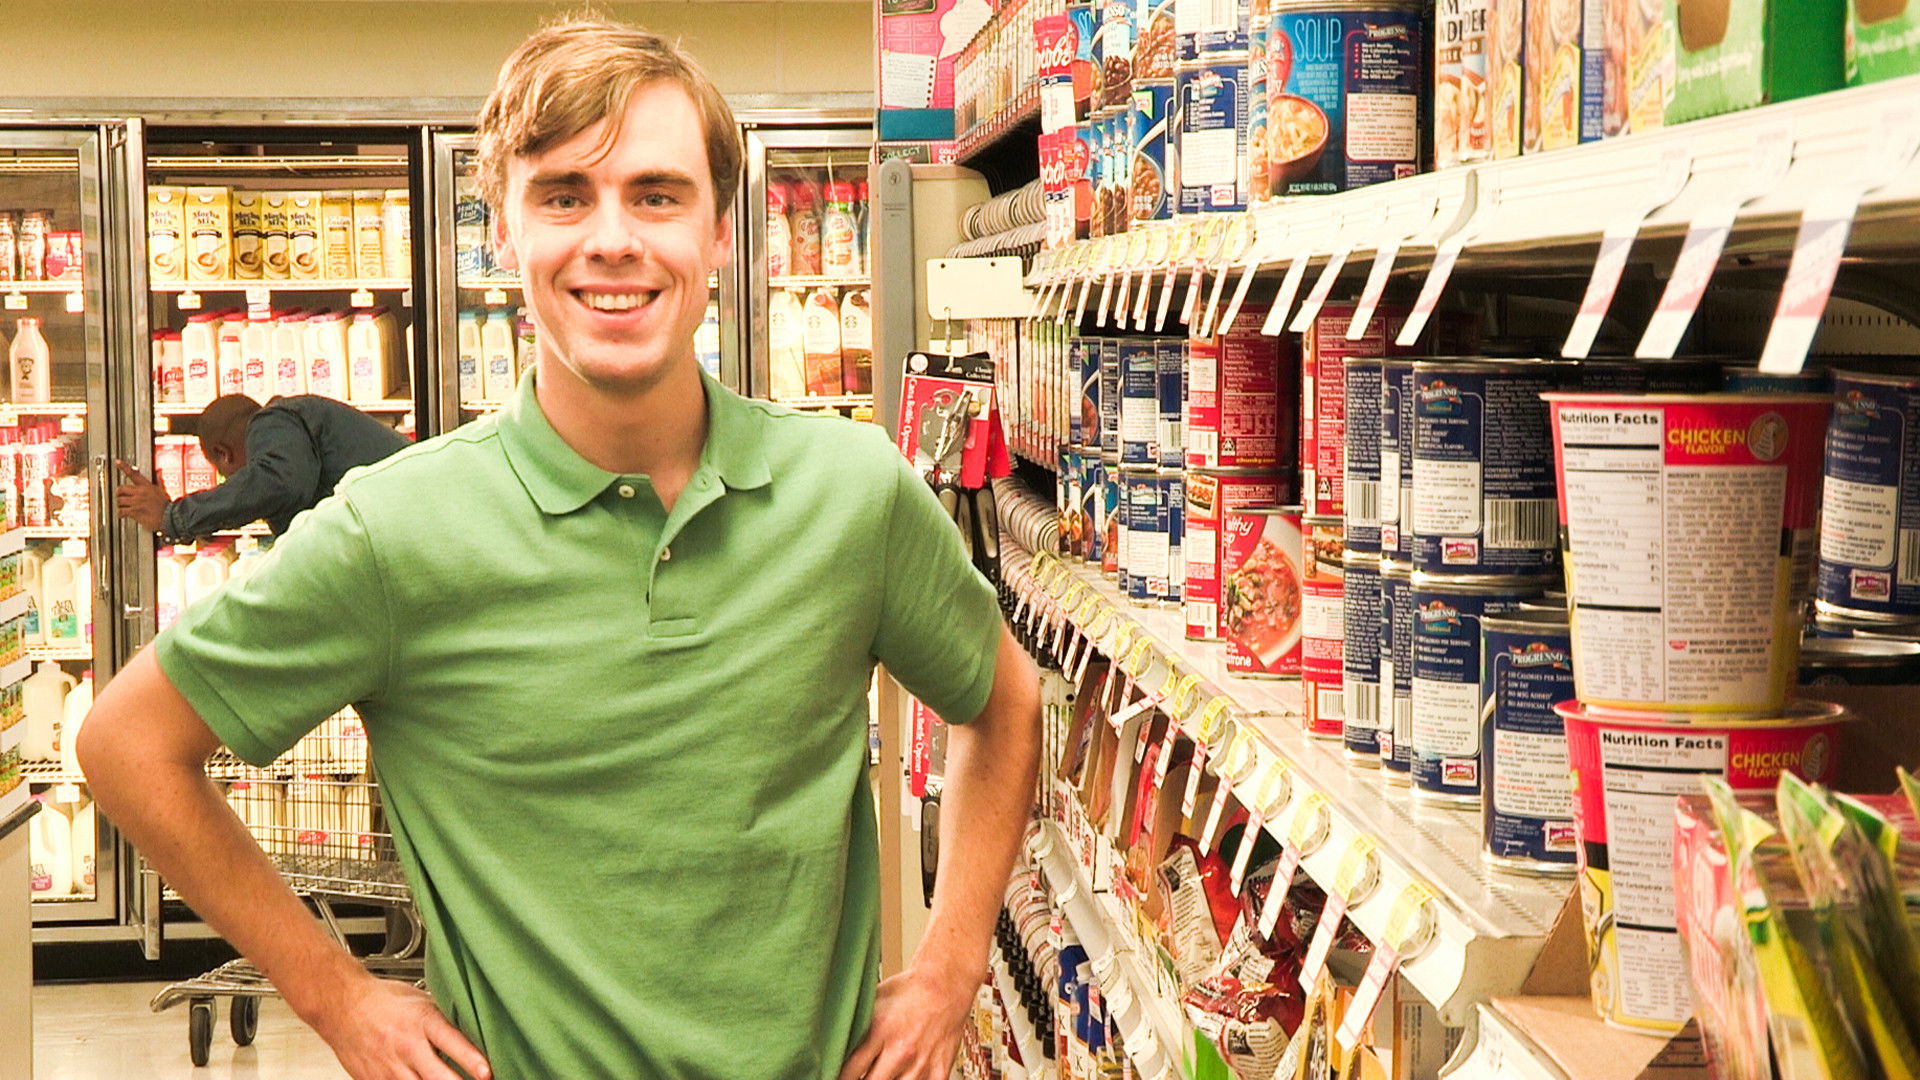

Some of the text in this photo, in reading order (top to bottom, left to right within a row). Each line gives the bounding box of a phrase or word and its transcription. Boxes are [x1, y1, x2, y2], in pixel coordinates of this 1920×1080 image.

[1294, 18, 1342, 62] SOUP
[880, 146, 920, 161] COLLECT
[1560, 412, 1658, 425] Nutrition Facts
[900, 425, 913, 456] Opener
[1667, 428, 1746, 445] CHICKEN
[1685, 444, 1727, 454] FLAVOR
[1421, 609, 1457, 619] PROGRESSO
[1512, 652, 1564, 664] PROGRESSO
[1516, 672, 1542, 681] CALORIES
[1516, 691, 1530, 699] MSG
[1507, 700, 1546, 710] NO ARTIFICIAL
[913, 717, 926, 774] Bottle Opener
[1602, 732, 1724, 750] Nutrition Facts
[1731, 752, 1801, 769] CHICKEN
[1748, 768, 1781, 778] FLAVO
